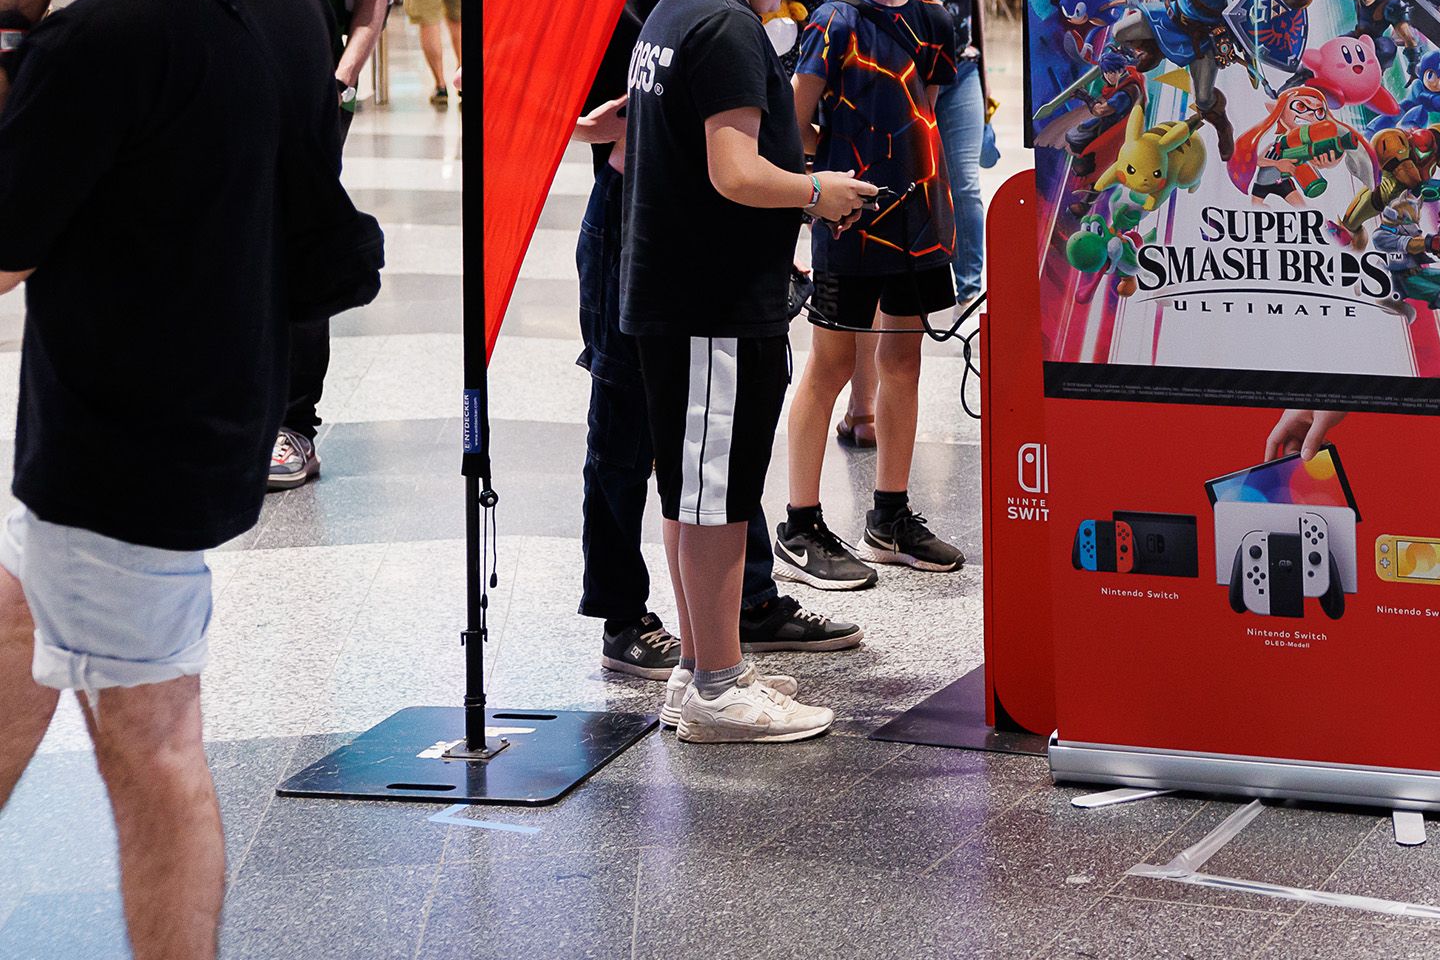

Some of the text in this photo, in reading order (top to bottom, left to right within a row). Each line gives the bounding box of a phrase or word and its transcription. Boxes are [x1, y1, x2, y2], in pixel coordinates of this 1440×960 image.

[1200, 206, 1330, 245] SUPER
[1136, 245, 1400, 300] SMASH BROS.
[1174, 300, 1357, 318] ULTIMATE
[1007, 497, 1046, 507] NINTE
[1007, 506, 1049, 521] SWIT
[1101, 587, 1179, 600] Nintendo Switch
[1376, 605, 1421, 616] Nintendo
[1247, 628, 1327, 641] Nintendo Switch
[1264, 639, 1310, 648] OLED-Modell
